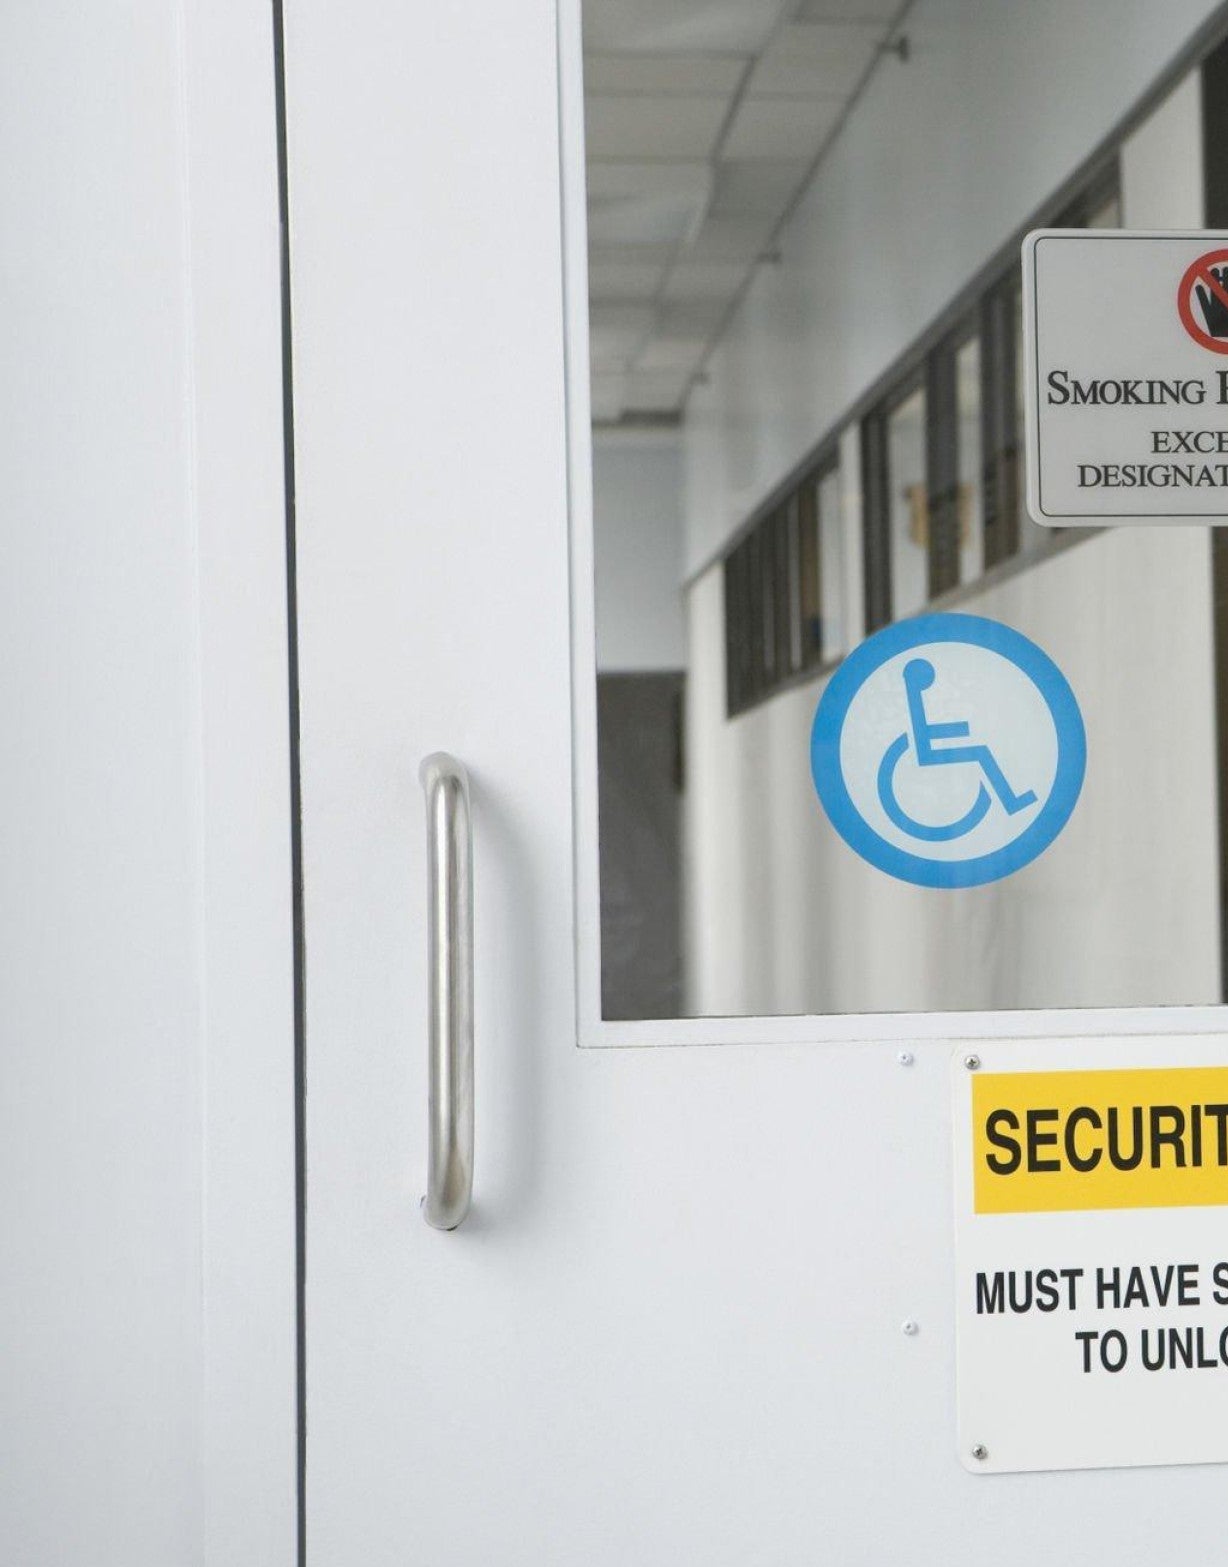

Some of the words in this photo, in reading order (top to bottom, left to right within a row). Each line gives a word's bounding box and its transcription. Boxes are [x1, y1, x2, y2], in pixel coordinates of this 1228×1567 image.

[1047, 370, 1207, 405] SMOKING
[976, 1268, 1084, 1315] MUST
[1096, 1264, 1200, 1310] HAVE
[1075, 1329, 1128, 1374] TO
